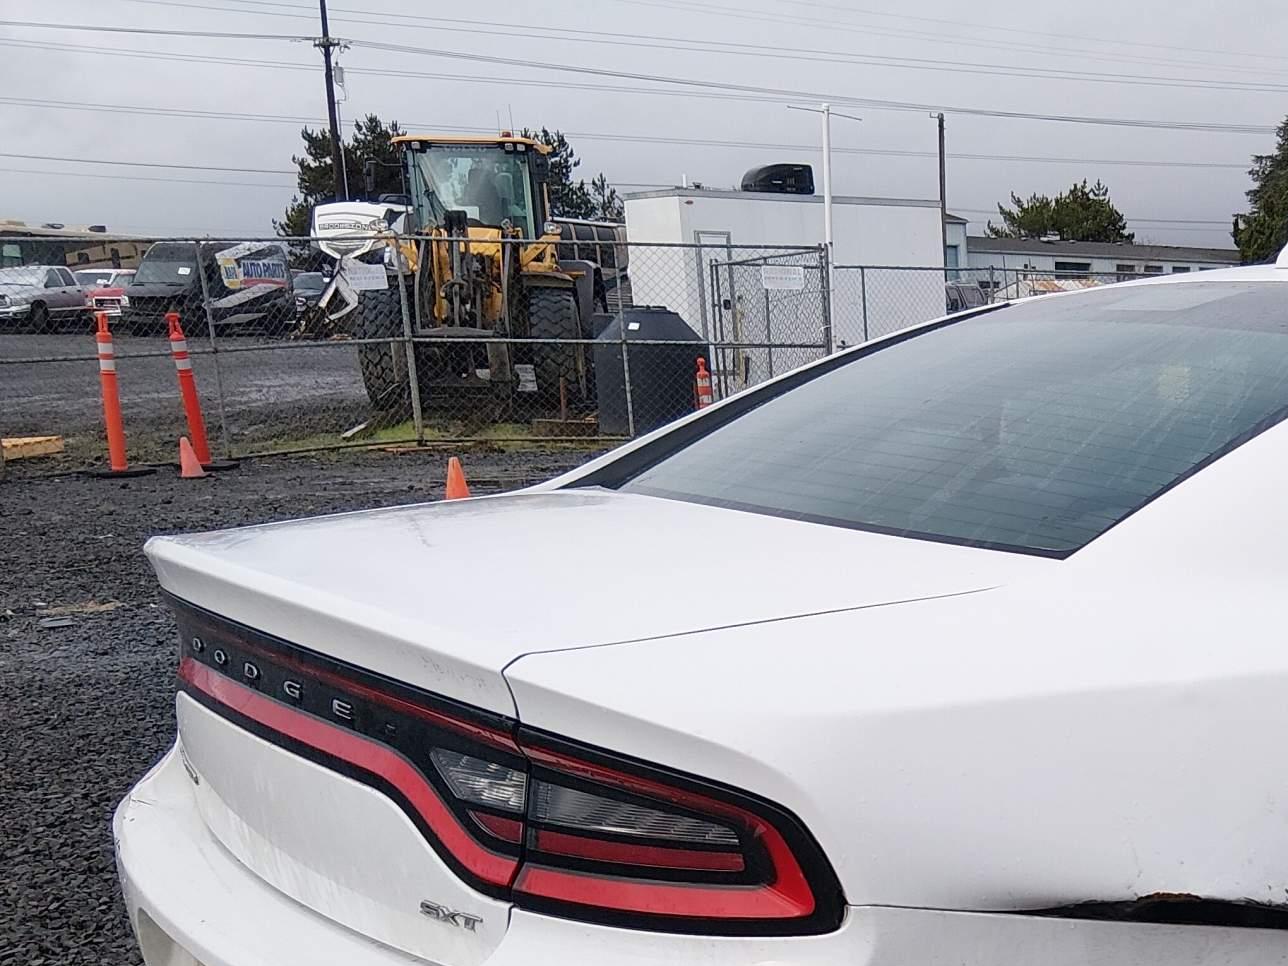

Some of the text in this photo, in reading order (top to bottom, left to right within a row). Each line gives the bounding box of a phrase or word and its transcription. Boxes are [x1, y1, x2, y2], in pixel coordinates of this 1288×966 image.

[243, 262, 285, 278] AUTO PARTS
[192, 637, 352, 720] DODGE
[420, 899, 483, 934] SXT
